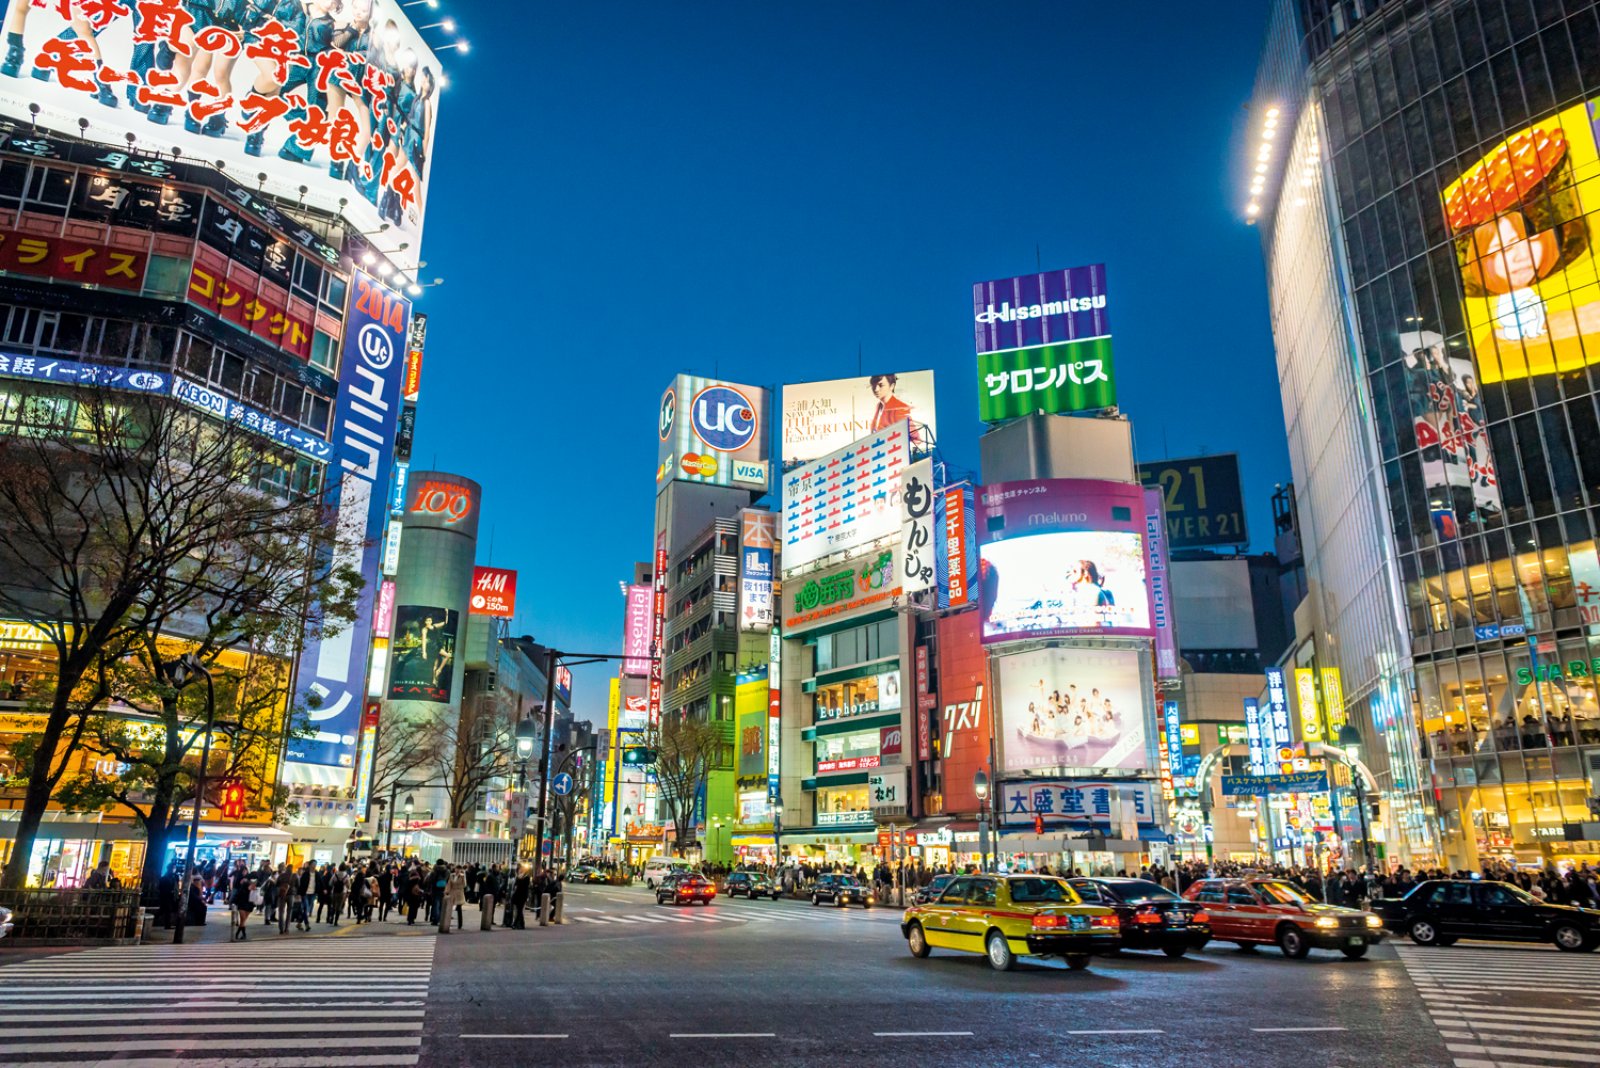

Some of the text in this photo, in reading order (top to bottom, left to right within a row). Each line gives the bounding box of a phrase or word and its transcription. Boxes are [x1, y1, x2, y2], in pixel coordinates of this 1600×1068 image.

[162, 305, 176, 317] 7F
[189, 268, 308, 346] コンタクト
[192, 313, 206, 326] 7F
[355, 281, 404, 334] 2014
[975, 295, 1106, 325] Hisamitsu
[985, 359, 1108, 397] サロンパス
[699, 399, 752, 436] UC
[737, 466, 764, 479] VISA
[410, 488, 472, 523] 109
[903, 476, 934, 585] もんじゃ
[946, 494, 963, 599] 三千里薬品
[477, 572, 508, 593] H&M
[486, 602, 509, 612] 150m
[749, 593, 767, 603] まで
[757, 608, 772, 620] 地下
[626, 587, 645, 670] Essential
[820, 700, 877, 719] Euphoria
[882, 730, 901, 750] JTB
